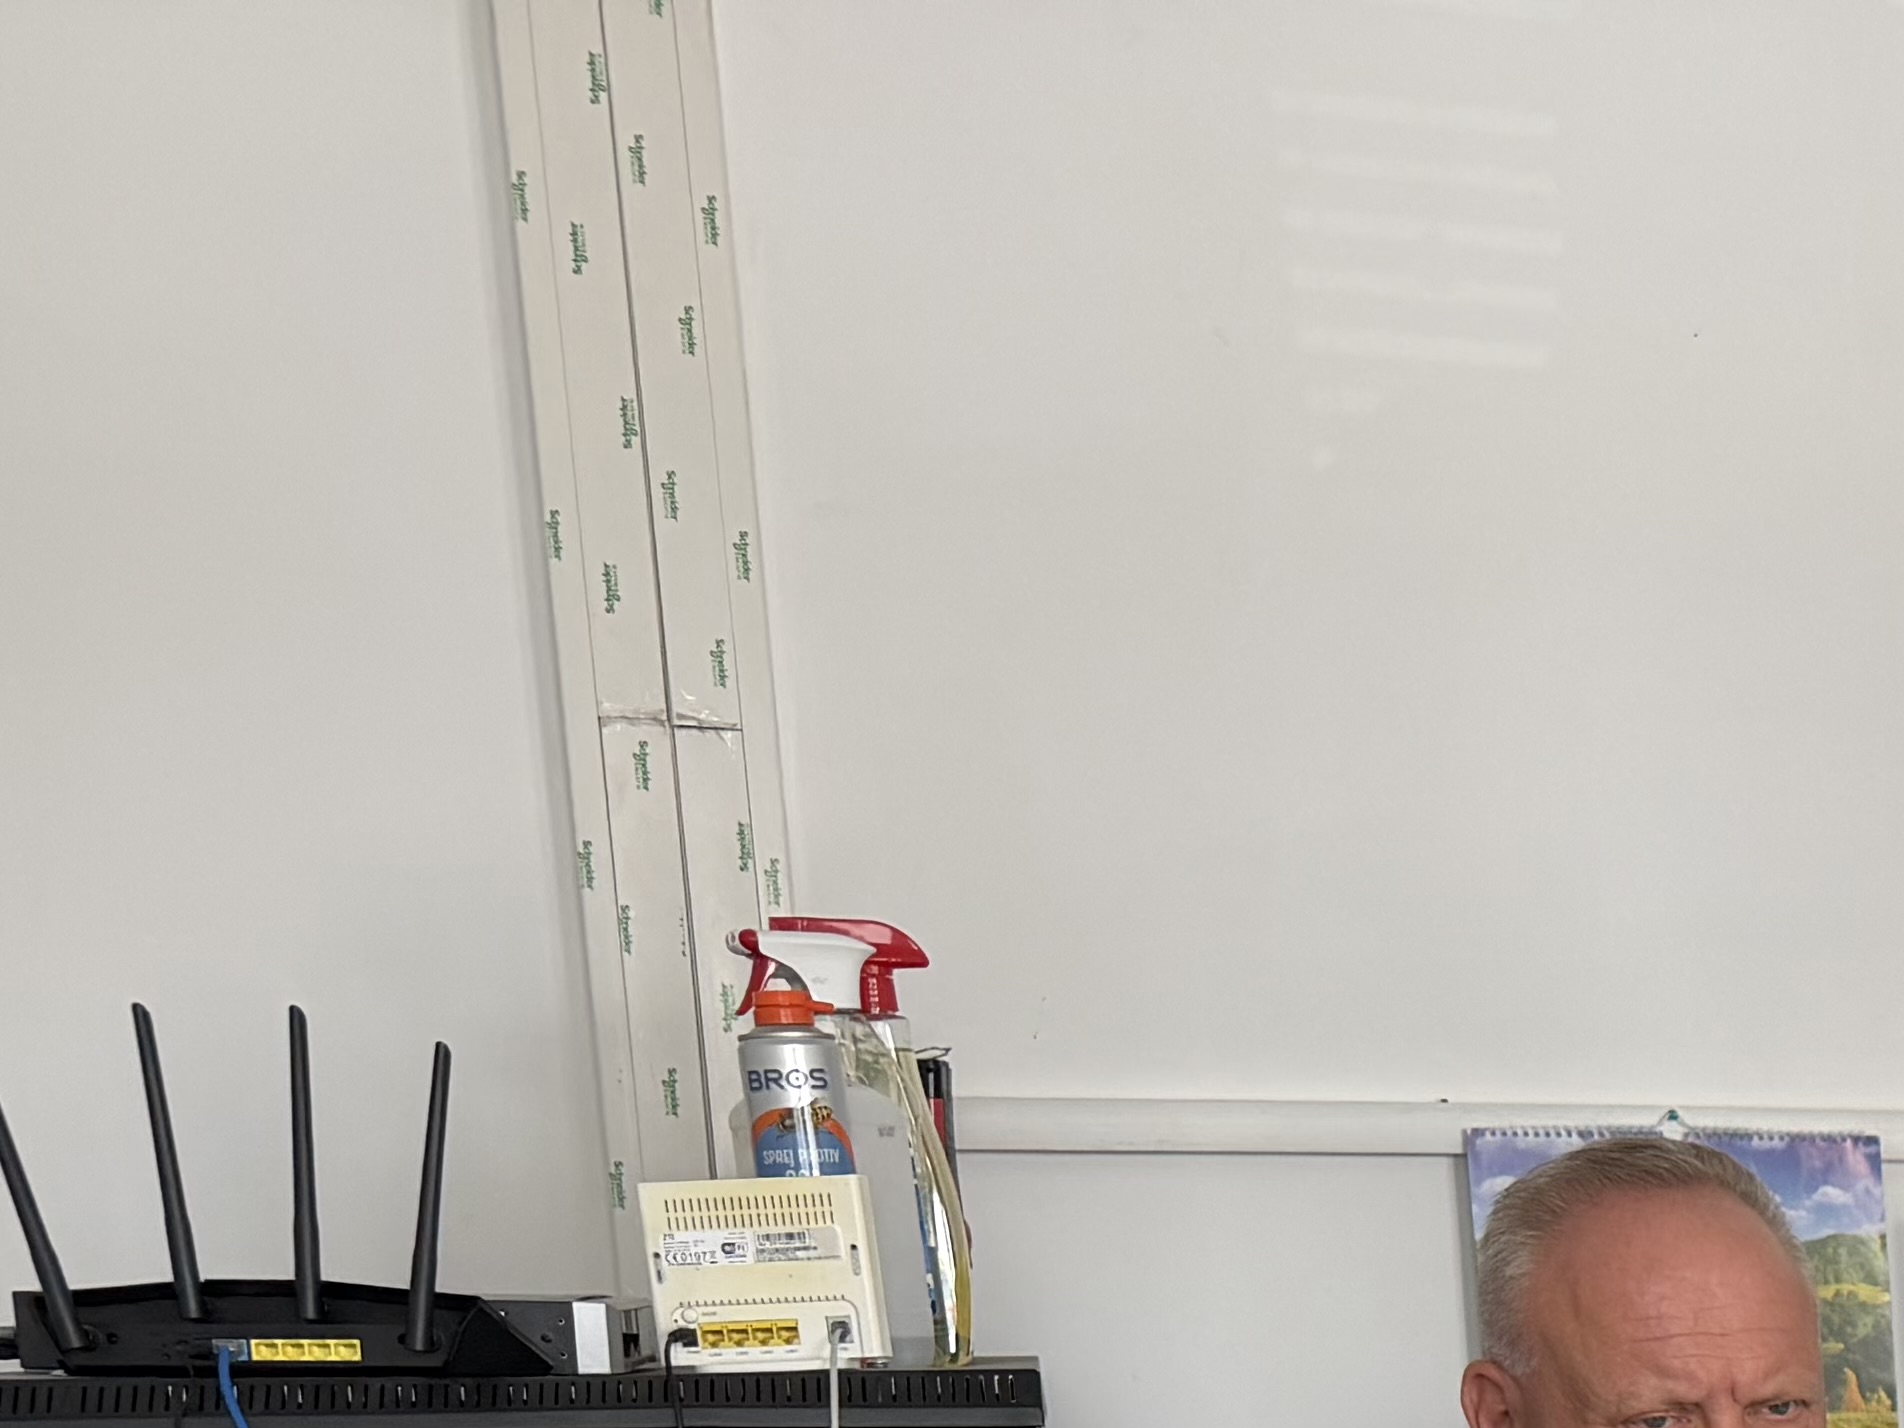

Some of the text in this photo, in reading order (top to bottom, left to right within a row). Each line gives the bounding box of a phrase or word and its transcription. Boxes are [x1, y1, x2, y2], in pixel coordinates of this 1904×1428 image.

[627, 134, 648, 187] Schneider
[701, 195, 720, 248] Schneider
[677, 305, 697, 357] Schneider
[619, 396, 639, 449] Schneider
[661, 470, 680, 523] Schneider
[733, 530, 751, 583] Schneider
[603, 561, 621, 614] Schneider
[710, 639, 727, 689] Schneider
[633, 740, 650, 792] Schneider
[577, 840, 595, 891] Schneider
[736, 821, 752, 872] Schneider
[764, 858, 782, 908] Schneider
[620, 904, 633, 956] Schneider
[662, 1067, 680, 1118] Schneider
[747, 1068, 829, 1091] BROS
[763, 1149, 839, 1167] SPREJ POTIV
[608, 1160, 627, 1211] Schneider
